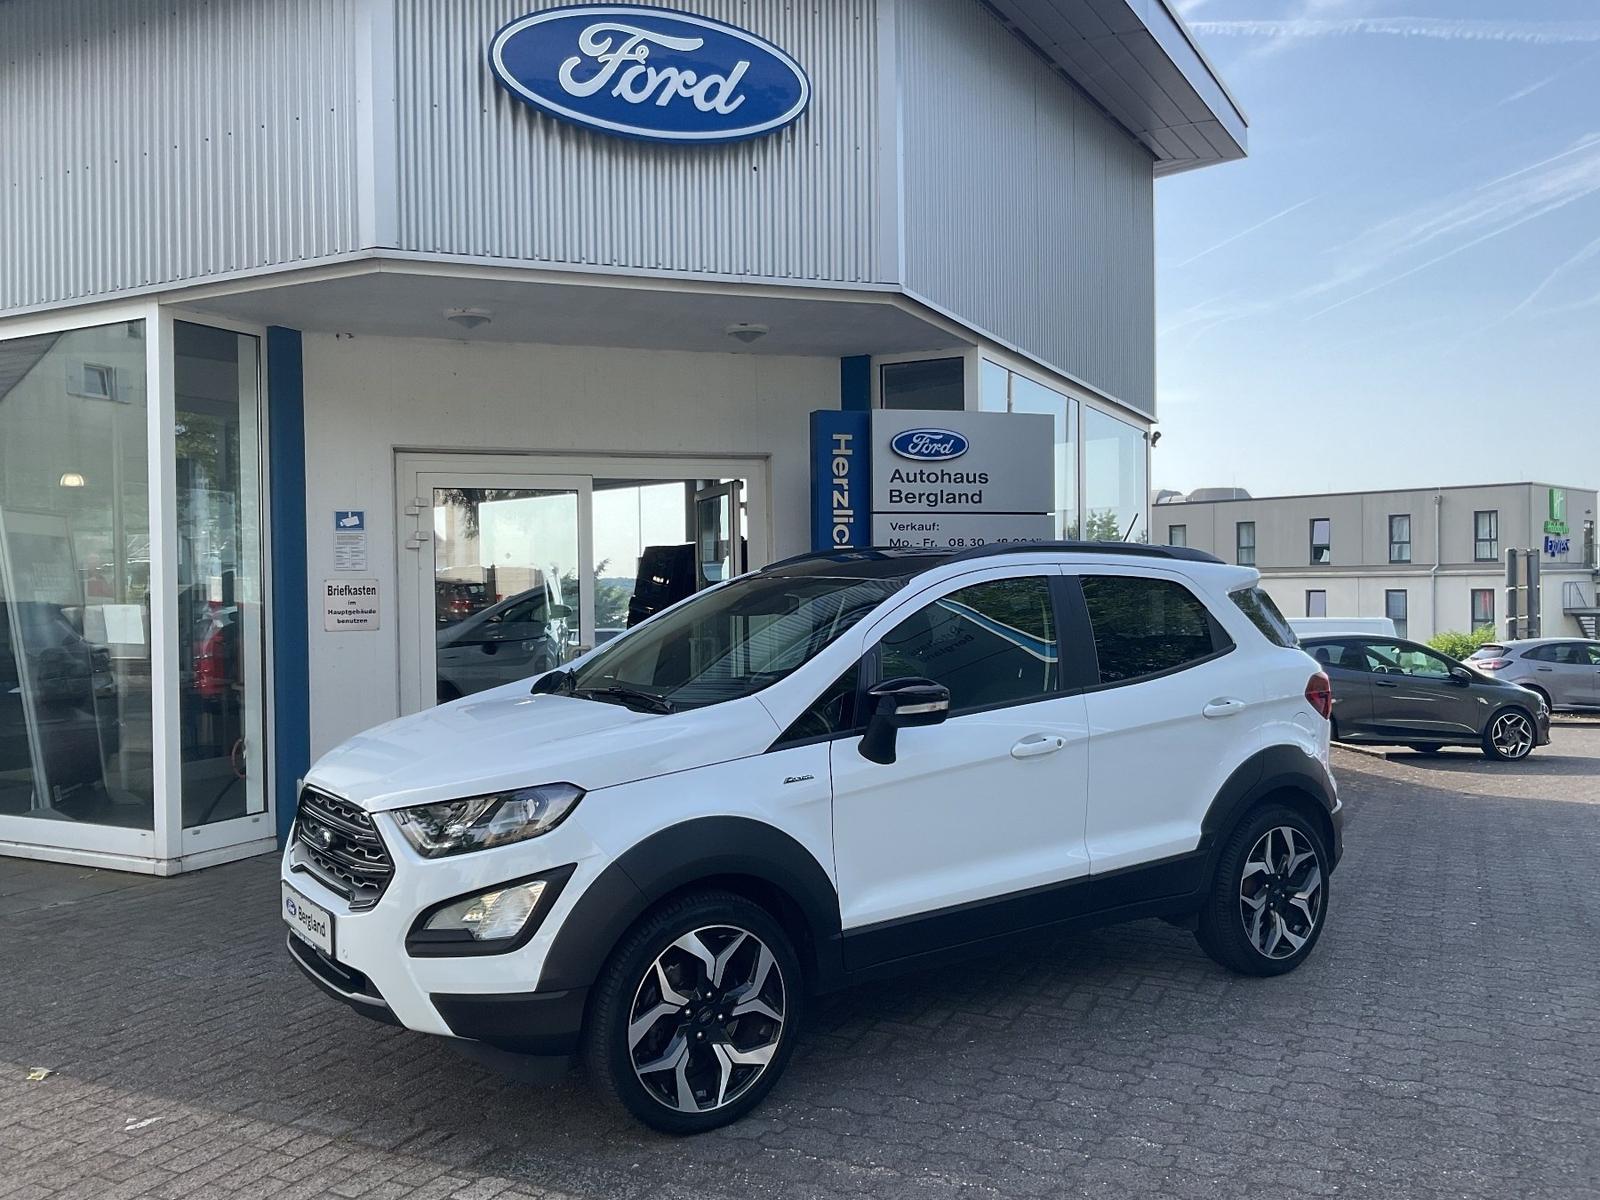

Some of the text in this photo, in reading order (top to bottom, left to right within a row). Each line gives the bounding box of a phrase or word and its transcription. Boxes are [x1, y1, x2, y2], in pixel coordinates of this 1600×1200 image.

[558, 22, 751, 115] Ford
[908, 433, 954, 455] Ford
[889, 468, 989, 484] Autohaus
[889, 489, 983, 508] Bergland
[889, 522, 941, 532] Verkauf:
[889, 538, 913, 548] Mo.
[922, 538, 939, 548] Fr.
[947, 538, 986, 548] 08.30
[327, 585, 376, 596] Briefkasten
[298, 905, 326, 937] Bergland
